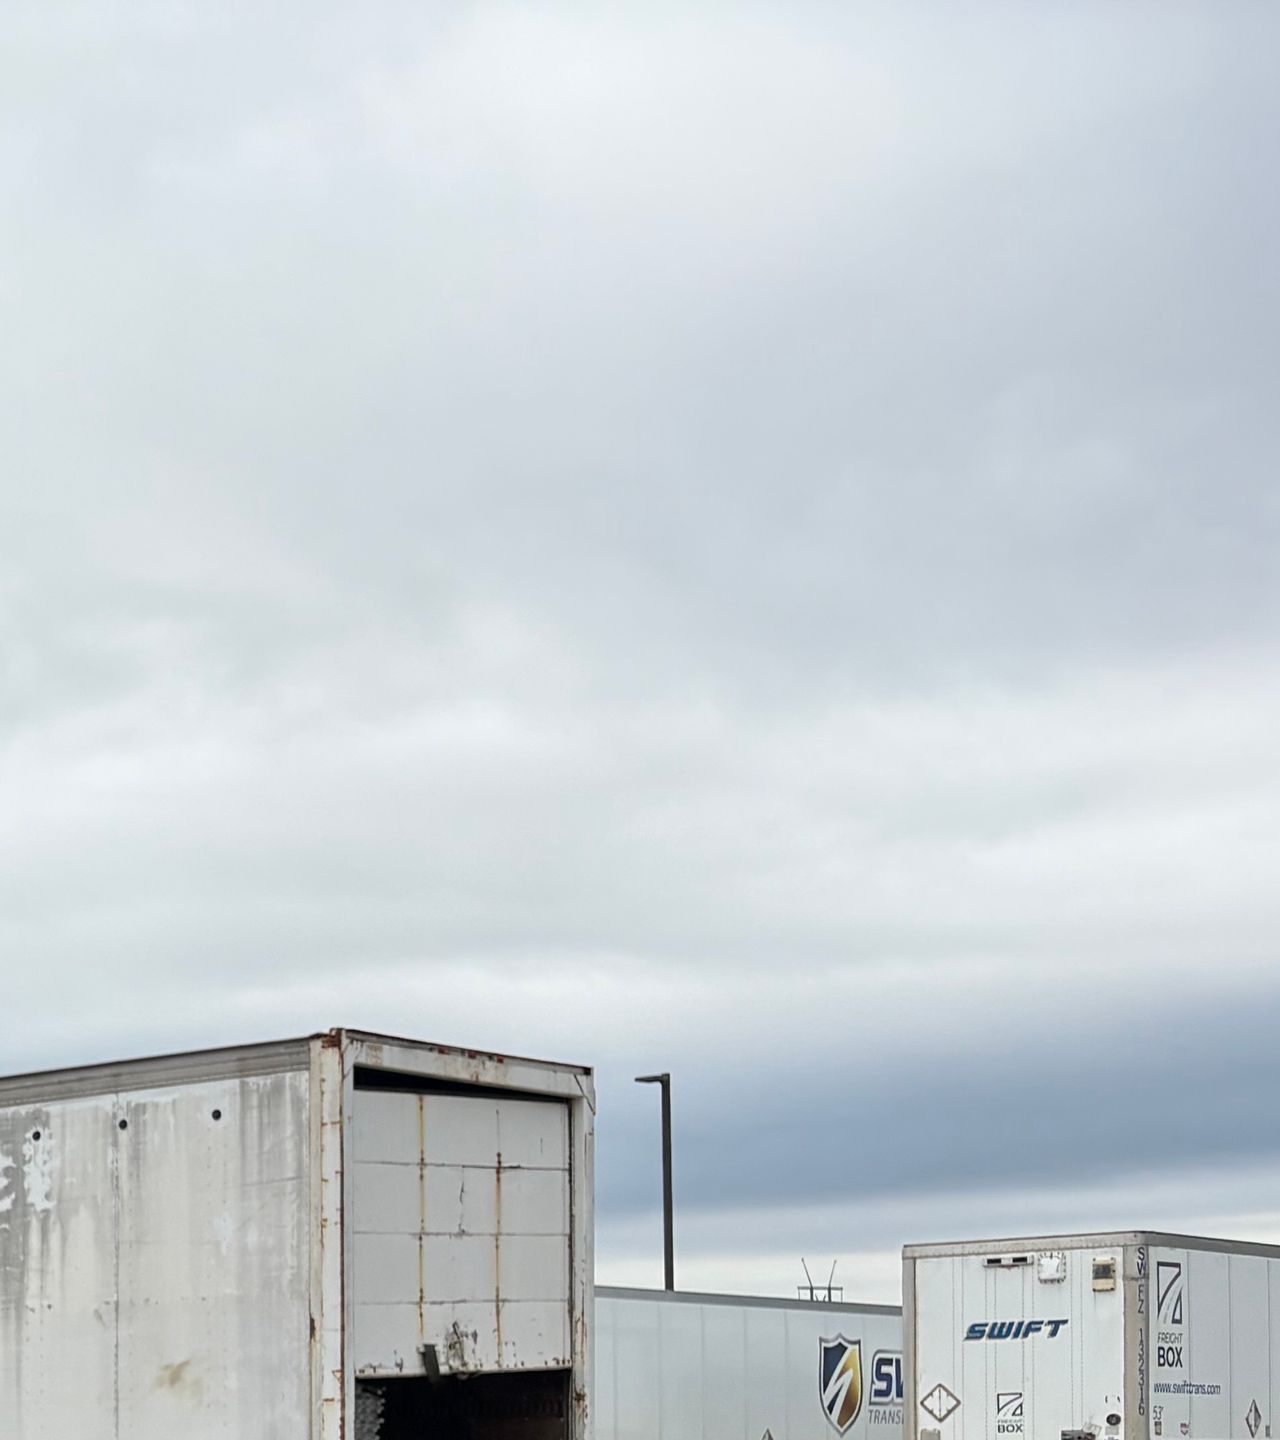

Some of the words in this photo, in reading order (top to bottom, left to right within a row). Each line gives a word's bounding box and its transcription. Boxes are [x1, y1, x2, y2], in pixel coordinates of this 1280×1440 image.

[963, 1319, 1069, 1341] SWIFT
[1157, 1332, 1183, 1344] FREIGHT
[1157, 1347, 1184, 1368] BOX
[997, 1424, 1024, 1433] BOX
